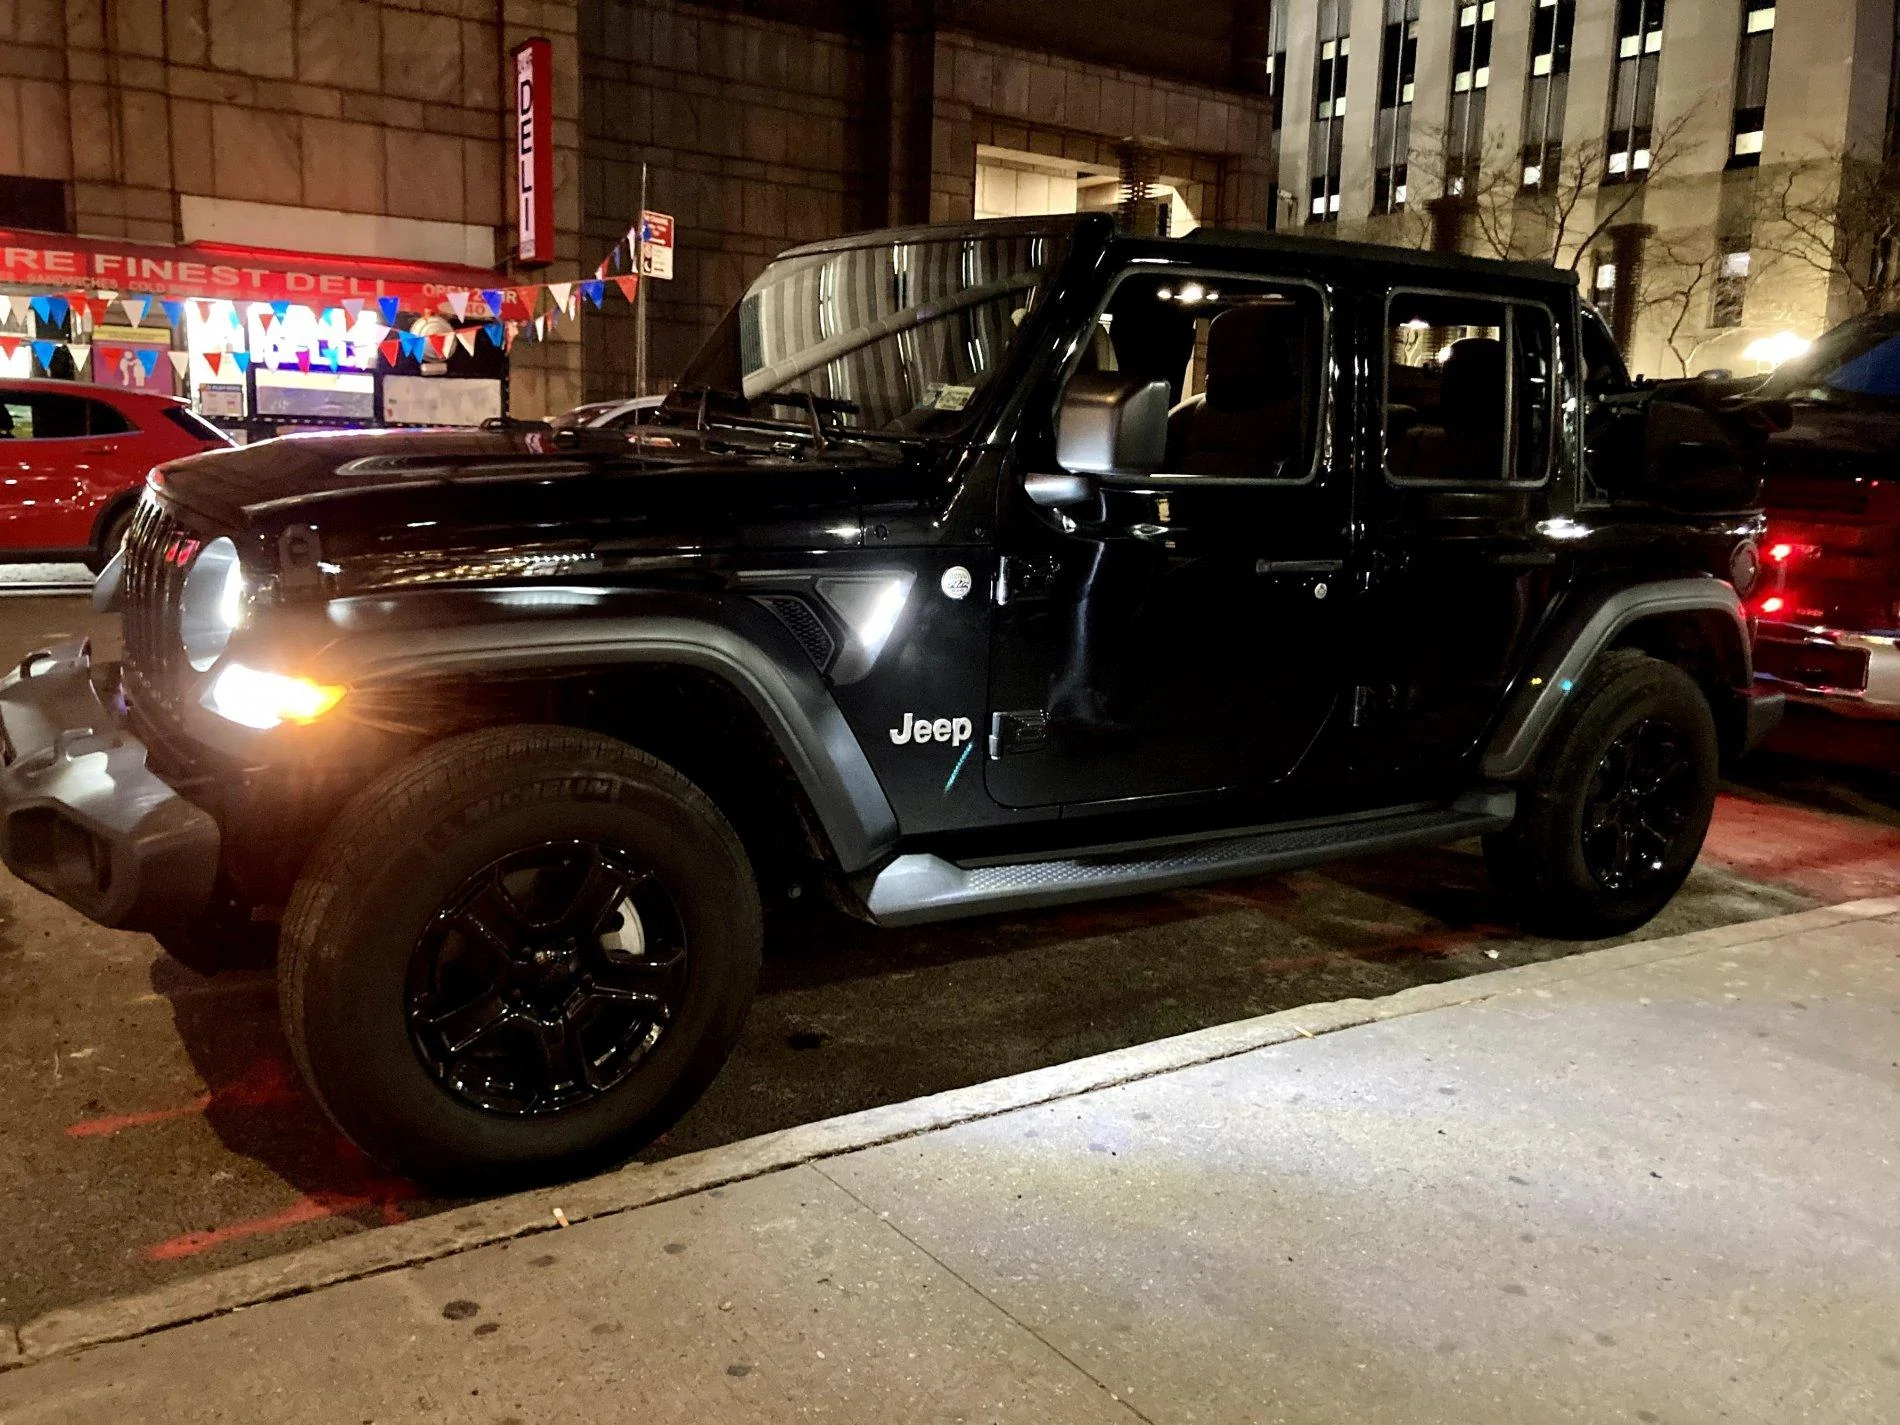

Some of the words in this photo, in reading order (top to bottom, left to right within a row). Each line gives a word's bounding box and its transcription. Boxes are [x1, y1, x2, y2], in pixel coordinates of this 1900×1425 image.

[520, 79, 533, 232] DELI
[5, 247, 75, 271] RE
[94, 253, 270, 288] FINEST
[286, 271, 386, 297] DELI
[889, 712, 973, 747] Jeep
